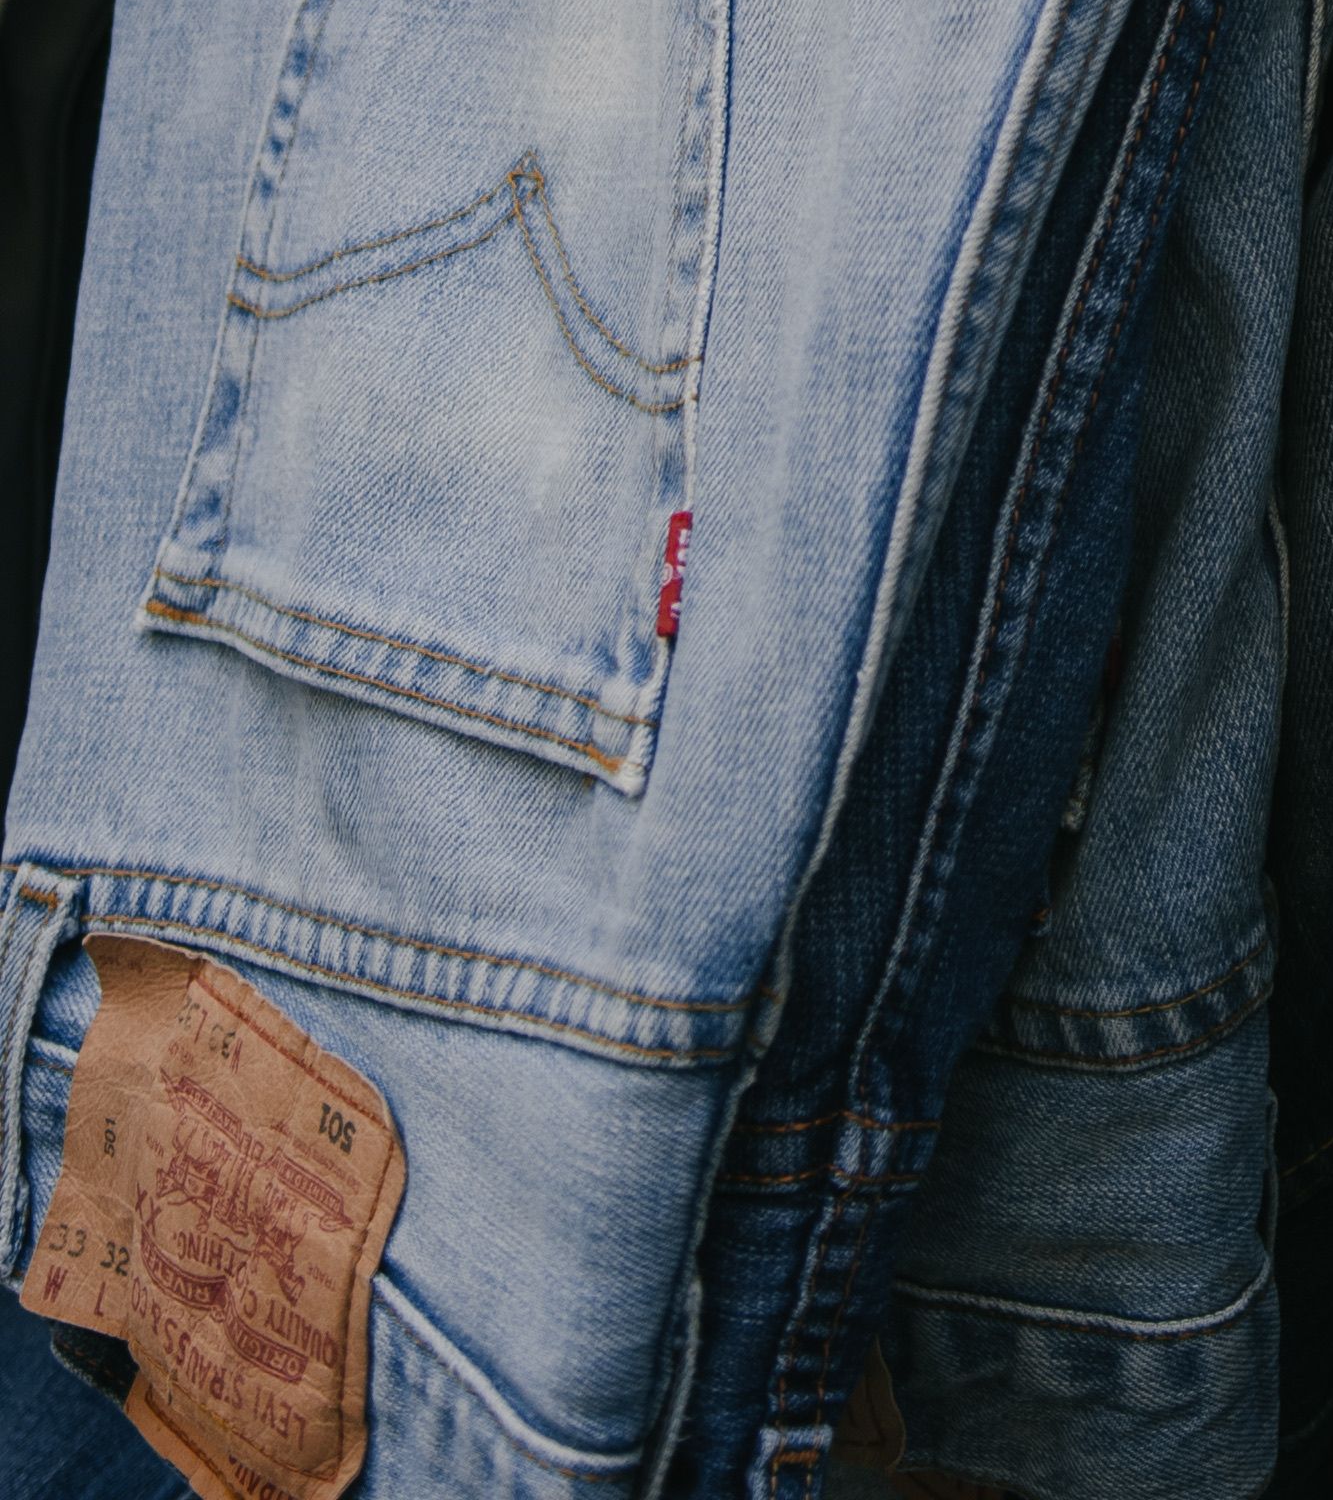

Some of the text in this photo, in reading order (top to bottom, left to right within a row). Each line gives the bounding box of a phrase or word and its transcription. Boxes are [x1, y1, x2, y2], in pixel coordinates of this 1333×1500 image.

[97, 1116, 121, 1159] 501
[314, 1101, 354, 1156] 501
[47, 1220, 133, 1277] 33 32
[41, 1263, 110, 1317] W L
[262, 1298, 336, 1369] QUALITY
[251, 1386, 306, 1452] LEVI
